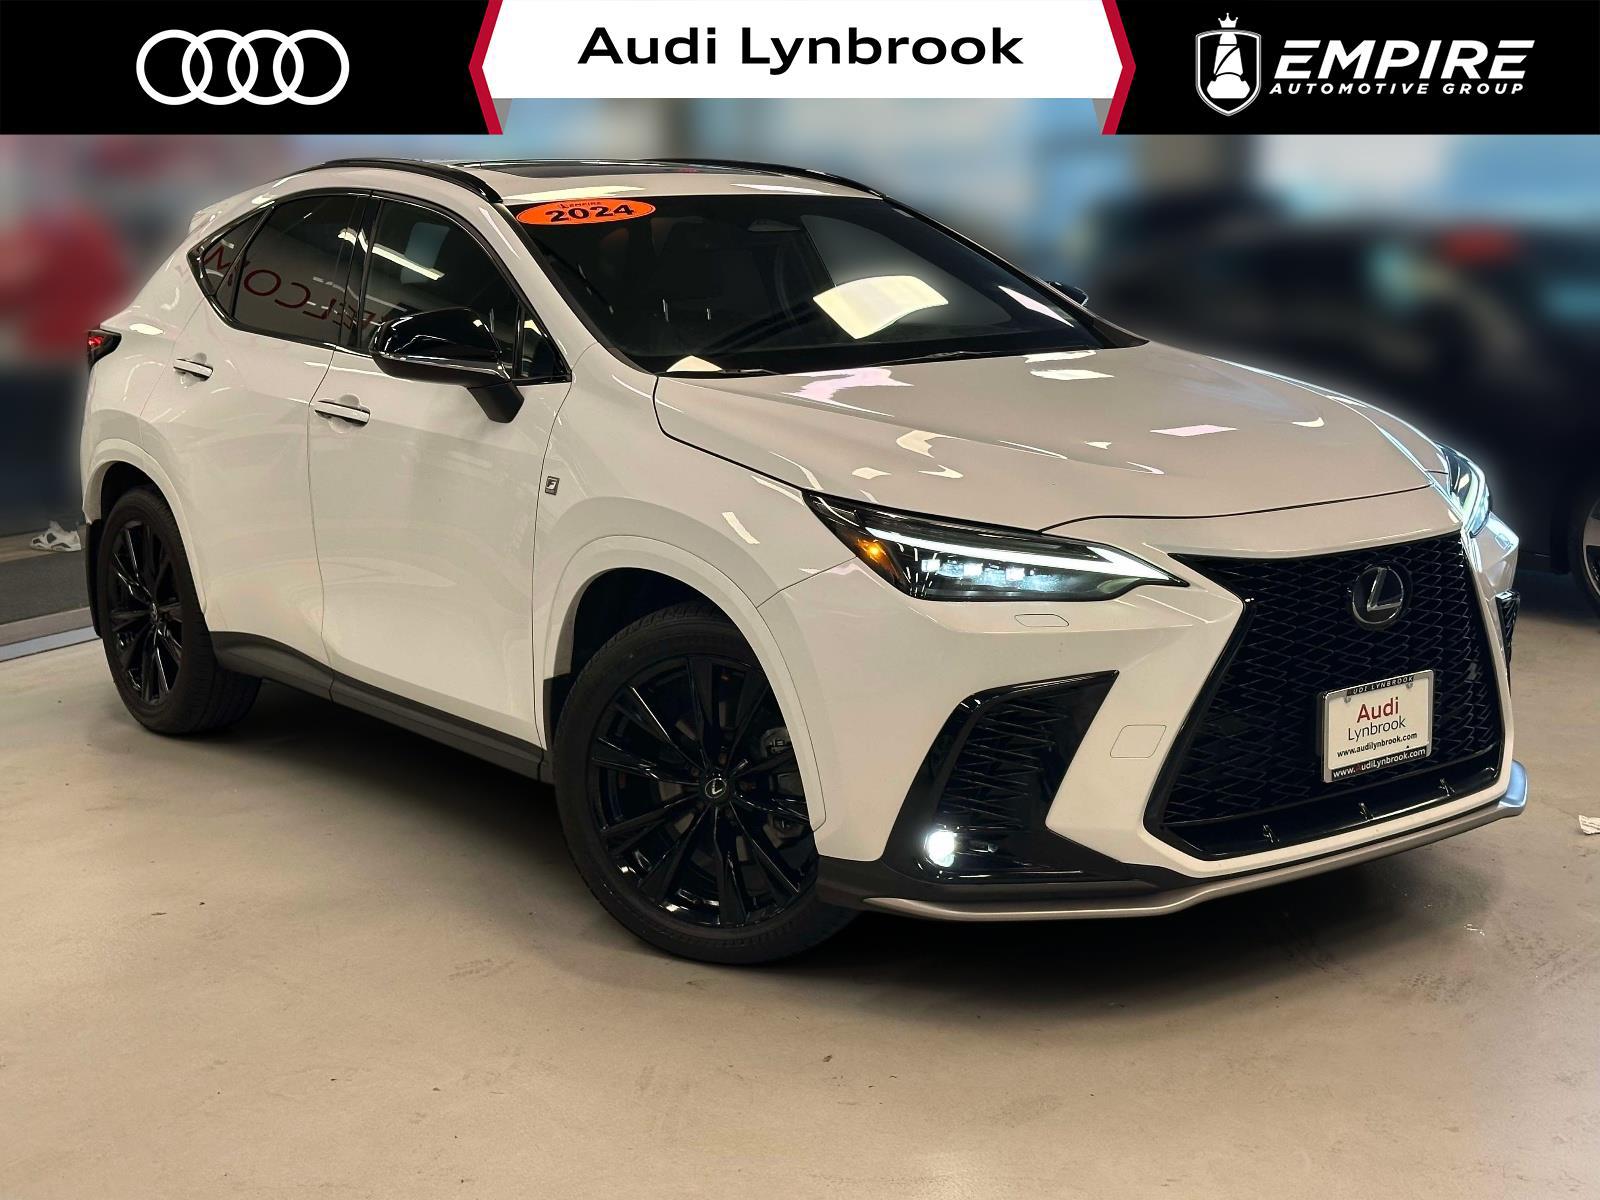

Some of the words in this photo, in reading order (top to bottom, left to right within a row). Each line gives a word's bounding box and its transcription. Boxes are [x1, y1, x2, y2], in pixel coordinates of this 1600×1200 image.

[545, 204, 634, 223] 2024
[1371, 676, 1415, 690] LYNBROOK
[1356, 697, 1399, 723] Audi
[1348, 716, 1407, 742] Lynbrook
[1336, 732, 1418, 758] www.audilynbrook.com
